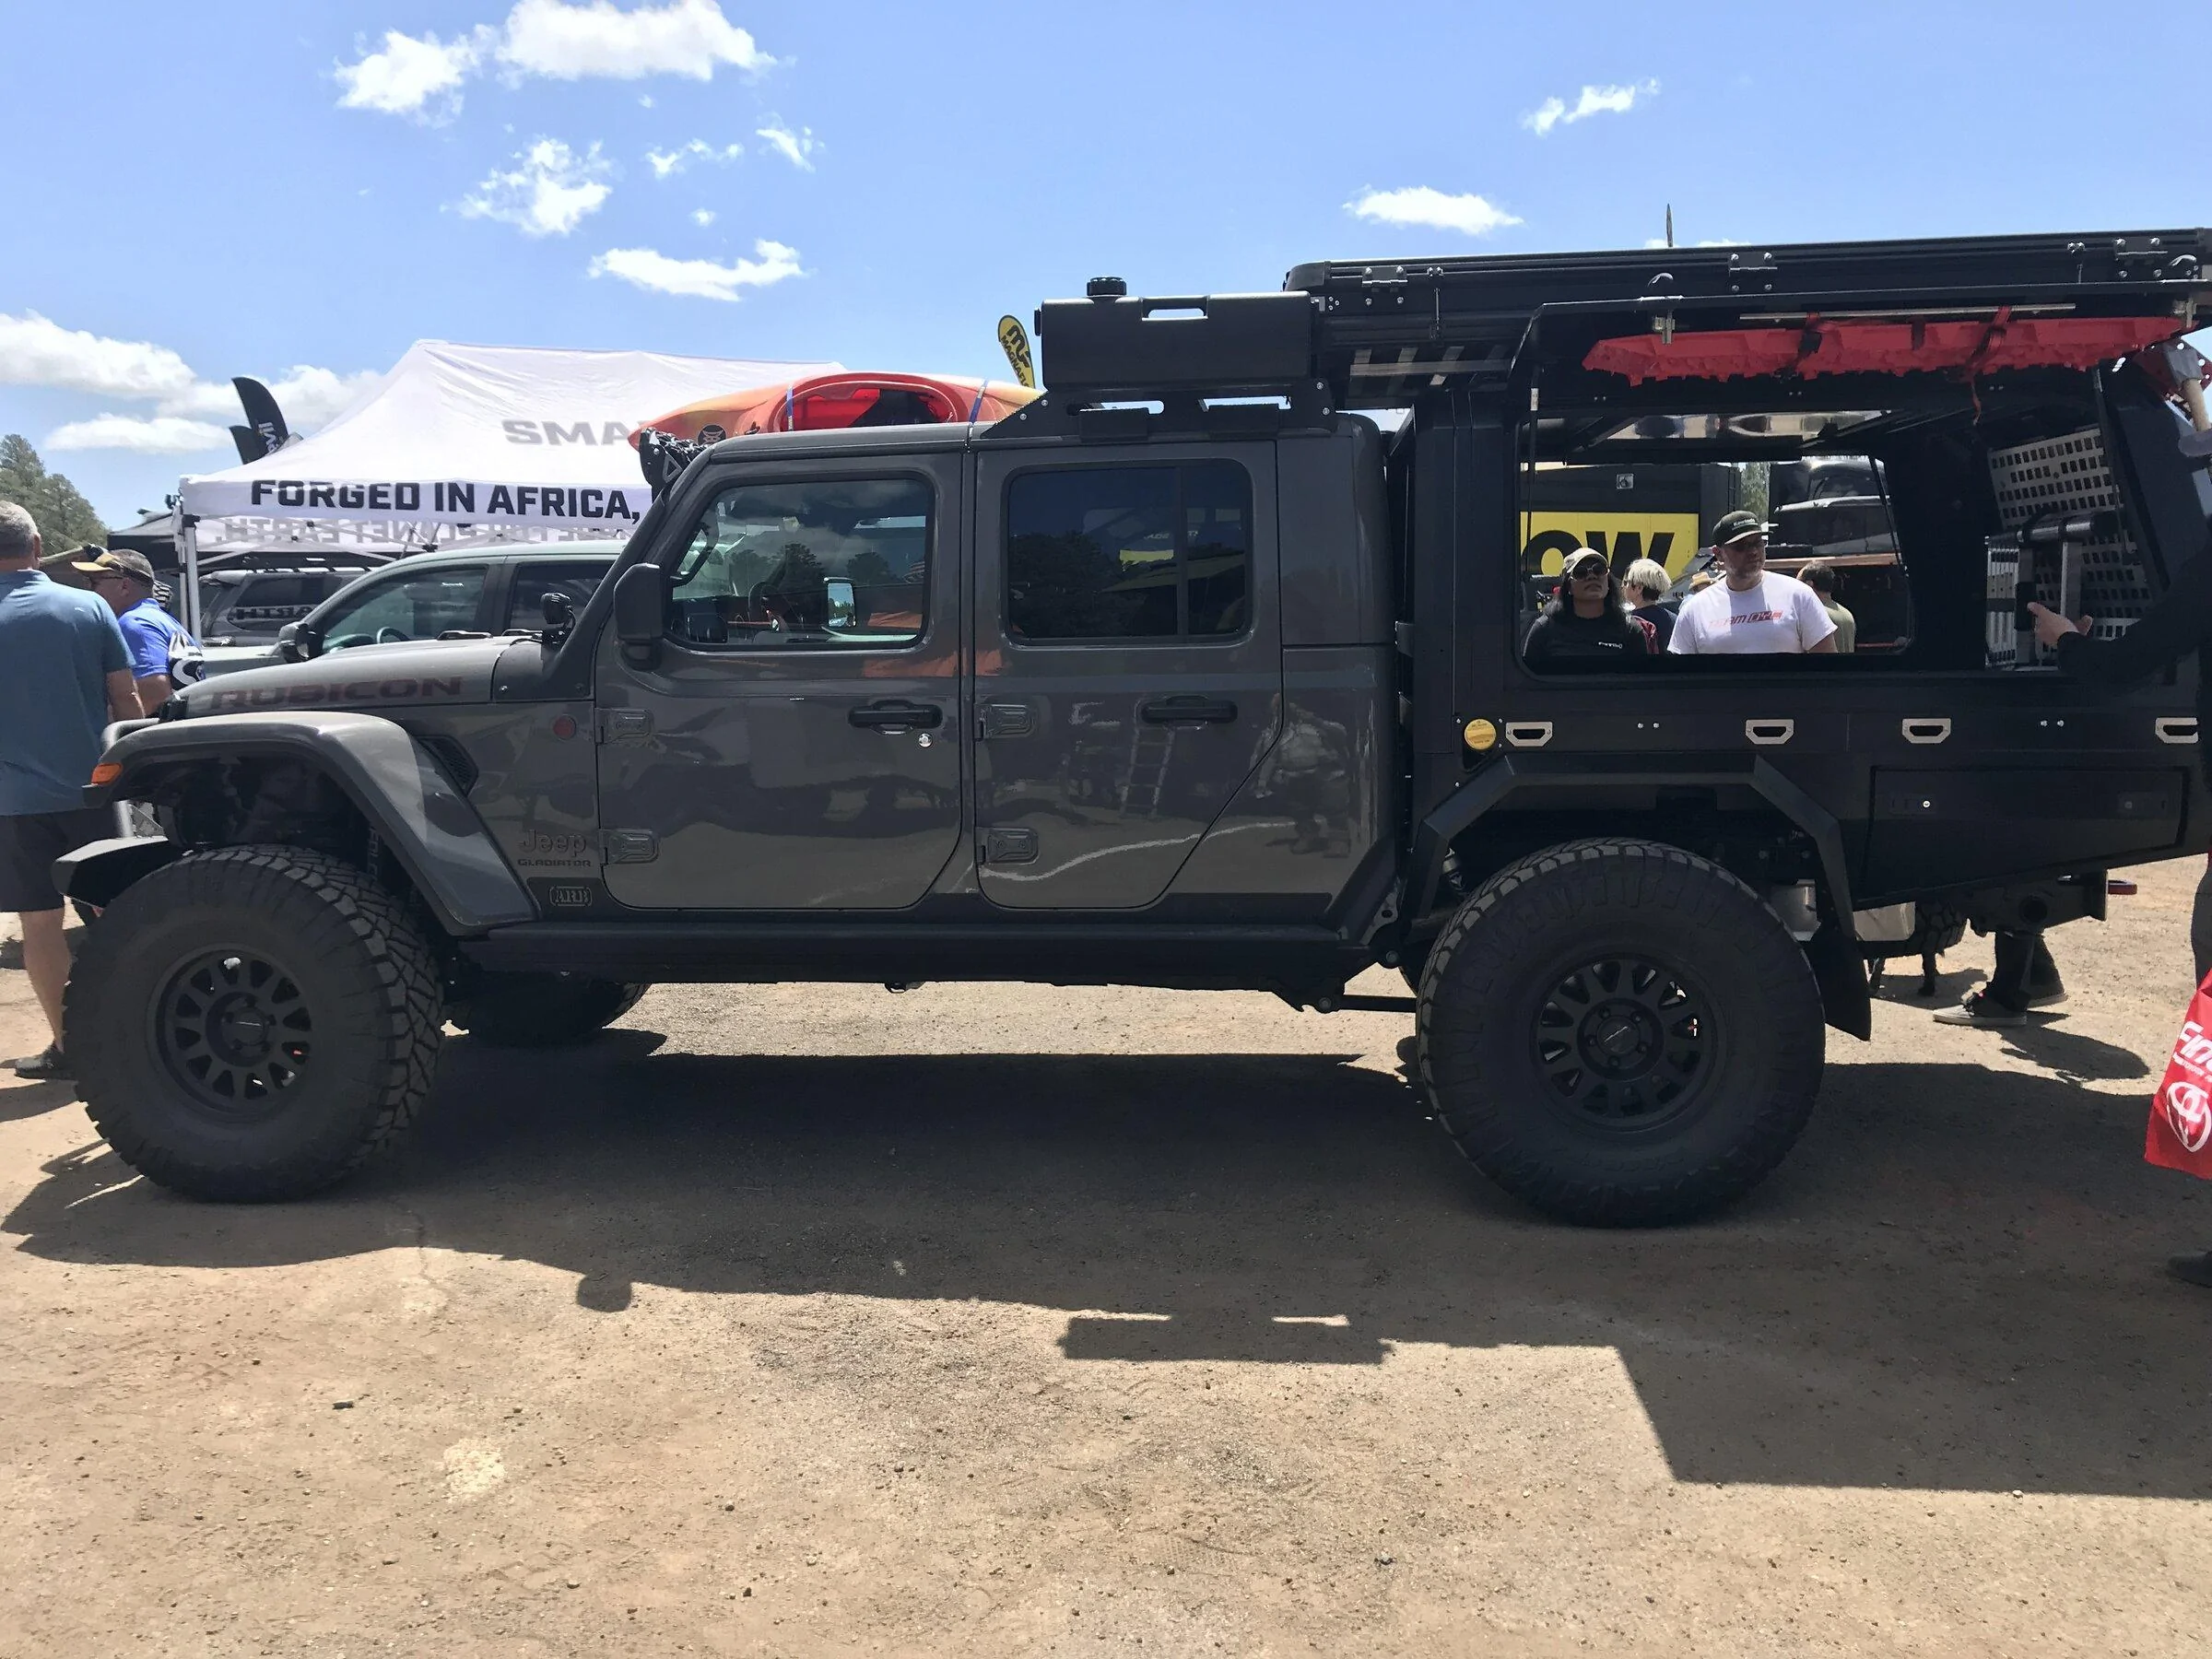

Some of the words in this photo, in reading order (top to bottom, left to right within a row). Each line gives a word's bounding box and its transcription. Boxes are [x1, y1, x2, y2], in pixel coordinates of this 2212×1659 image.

[501, 420, 645, 445] SMA
[252, 480, 419, 511] FORGED
[435, 482, 475, 512] IN
[487, 484, 641, 525] AFRICA,
[210, 677, 464, 710] RUBICON
[519, 830, 587, 857] Jeep
[518, 858, 592, 867] GLADIATOR
[553, 888, 591, 904] ARB
